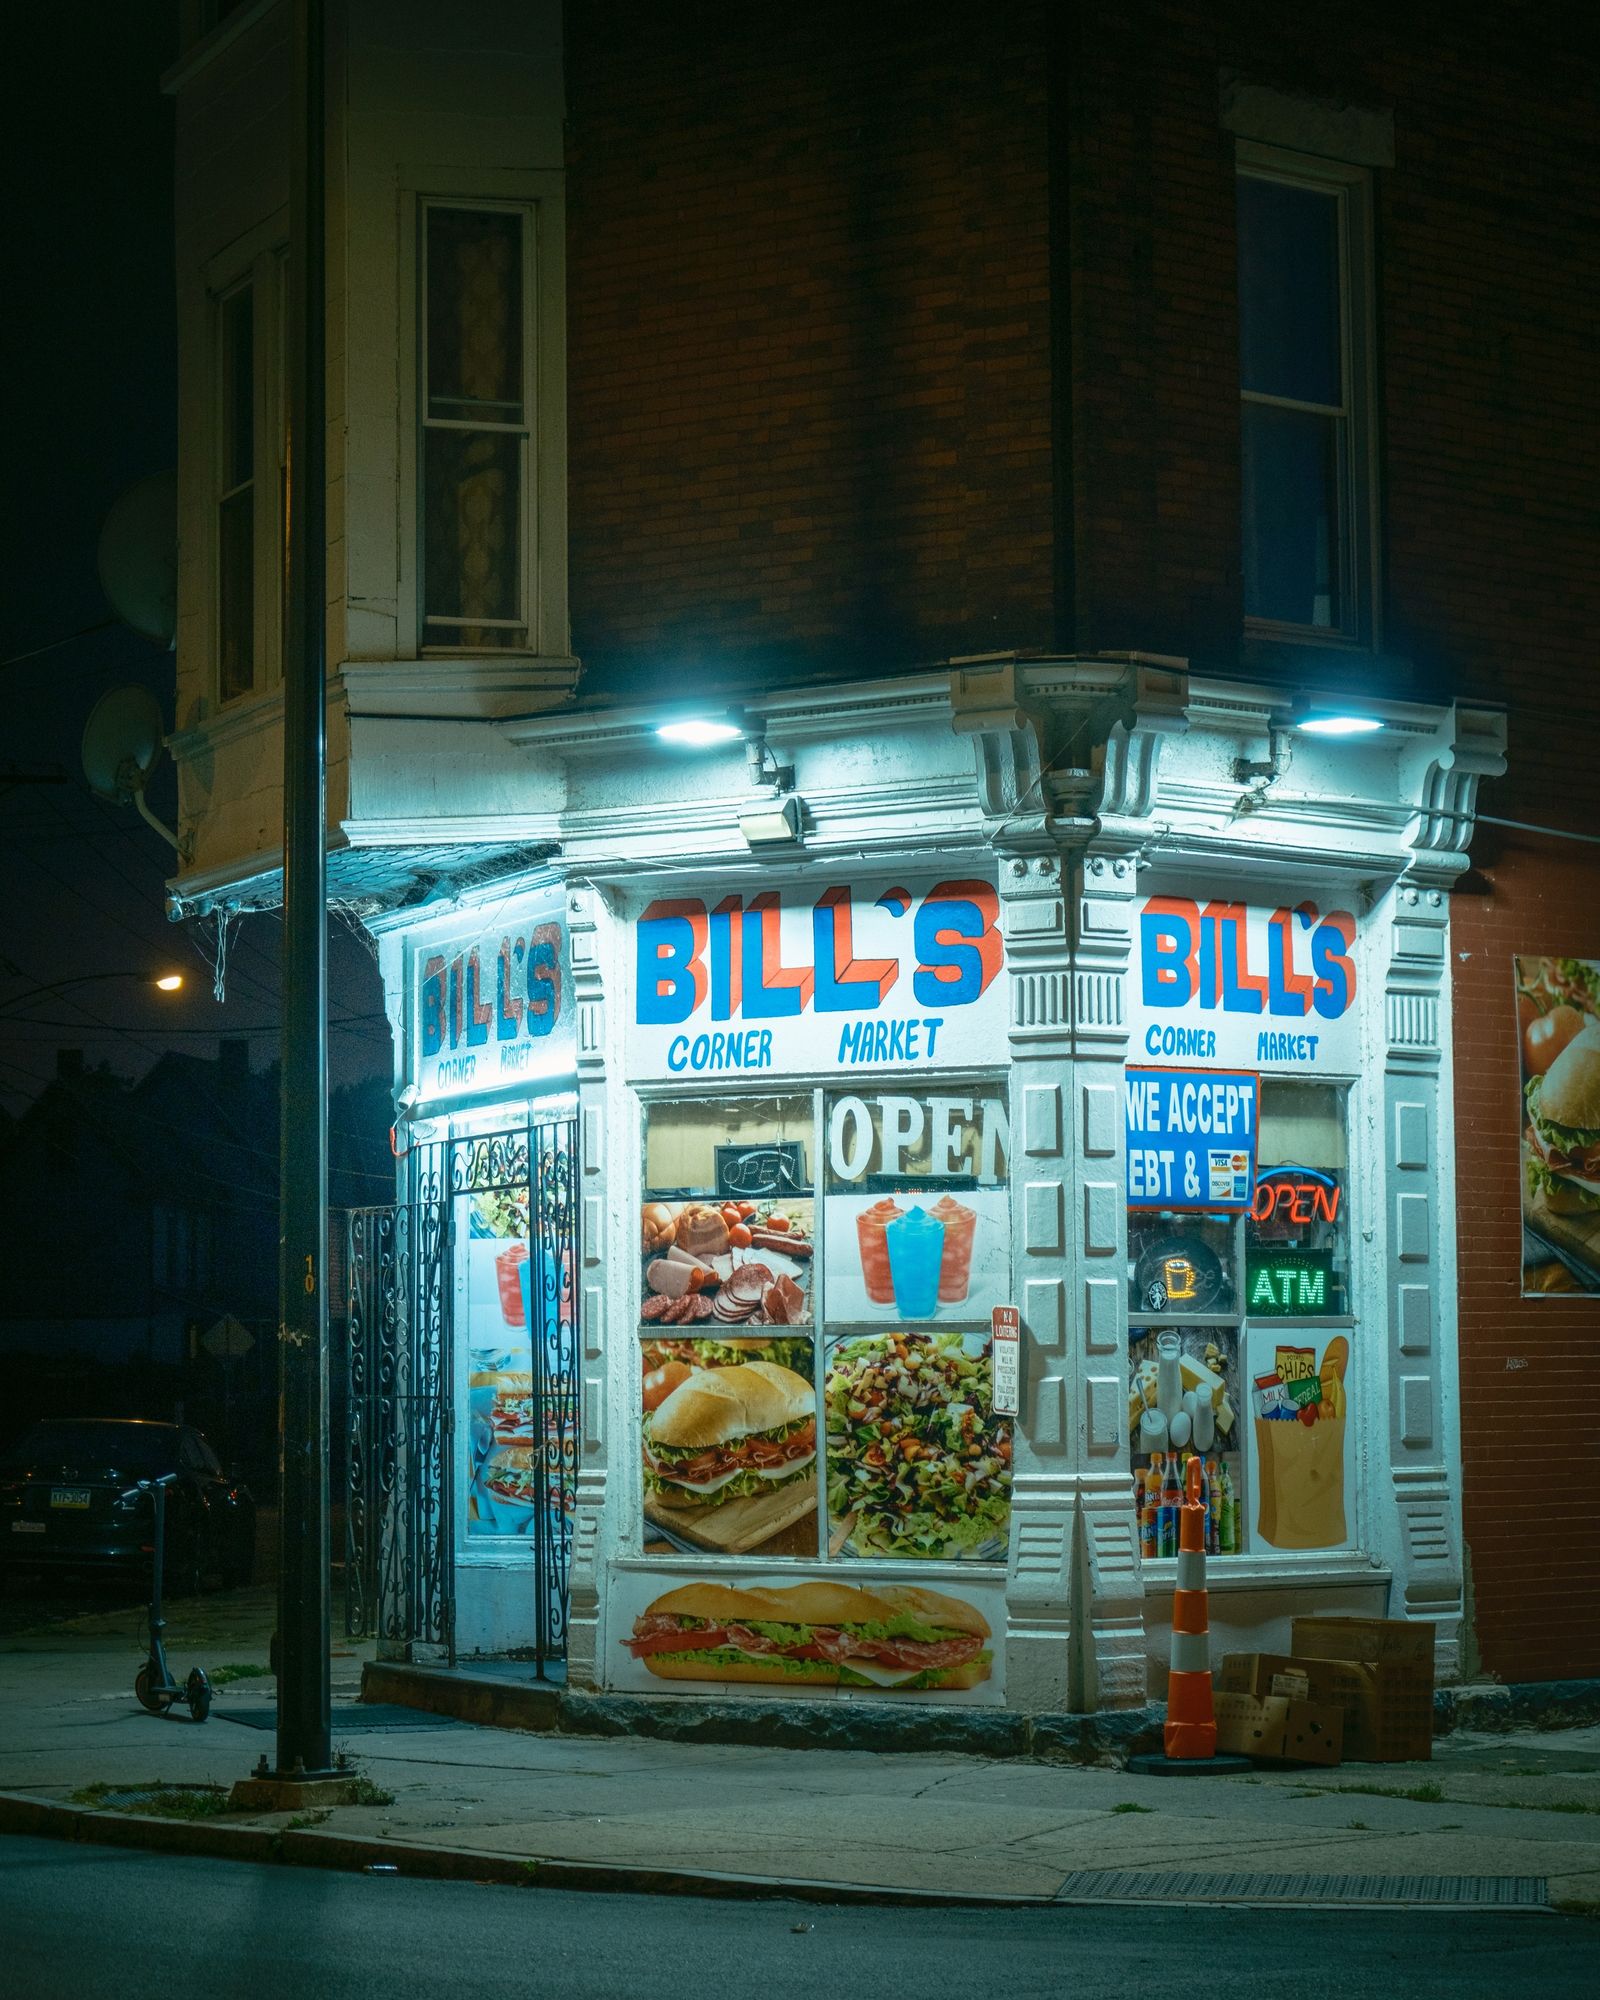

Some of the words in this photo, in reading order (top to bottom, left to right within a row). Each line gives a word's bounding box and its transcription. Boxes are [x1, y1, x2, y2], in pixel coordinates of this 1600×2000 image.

[636, 879, 1004, 1025] BILL'S
[1140, 895, 1357, 1019] BILL'S
[422, 921, 562, 1057] BILL'S
[667, 1029, 773, 1071] CORNER
[838, 1017, 944, 1063] MARKET
[1145, 1024, 1216, 1058] CORNER
[1257, 1032, 1319, 1061] MARKET
[437, 1054, 476, 1089] CORNER
[1125, 1081, 1160, 1132] WE
[1167, 1082, 1253, 1134] ACCEPT
[722, 1156, 795, 1186] OPEN
[1129, 1150, 1174, 1197] EBT
[1184, 1150, 1201, 1198] &
[1214, 1158, 1228, 1167] VISA
[1248, 1184, 1340, 1223] OPEN
[1252, 1269, 1324, 1304] ATM
[1003, 1310, 1012, 1323] NO
[1276, 1361, 1314, 1381] CHIPS
[1262, 1387, 1285, 1403] MILK
